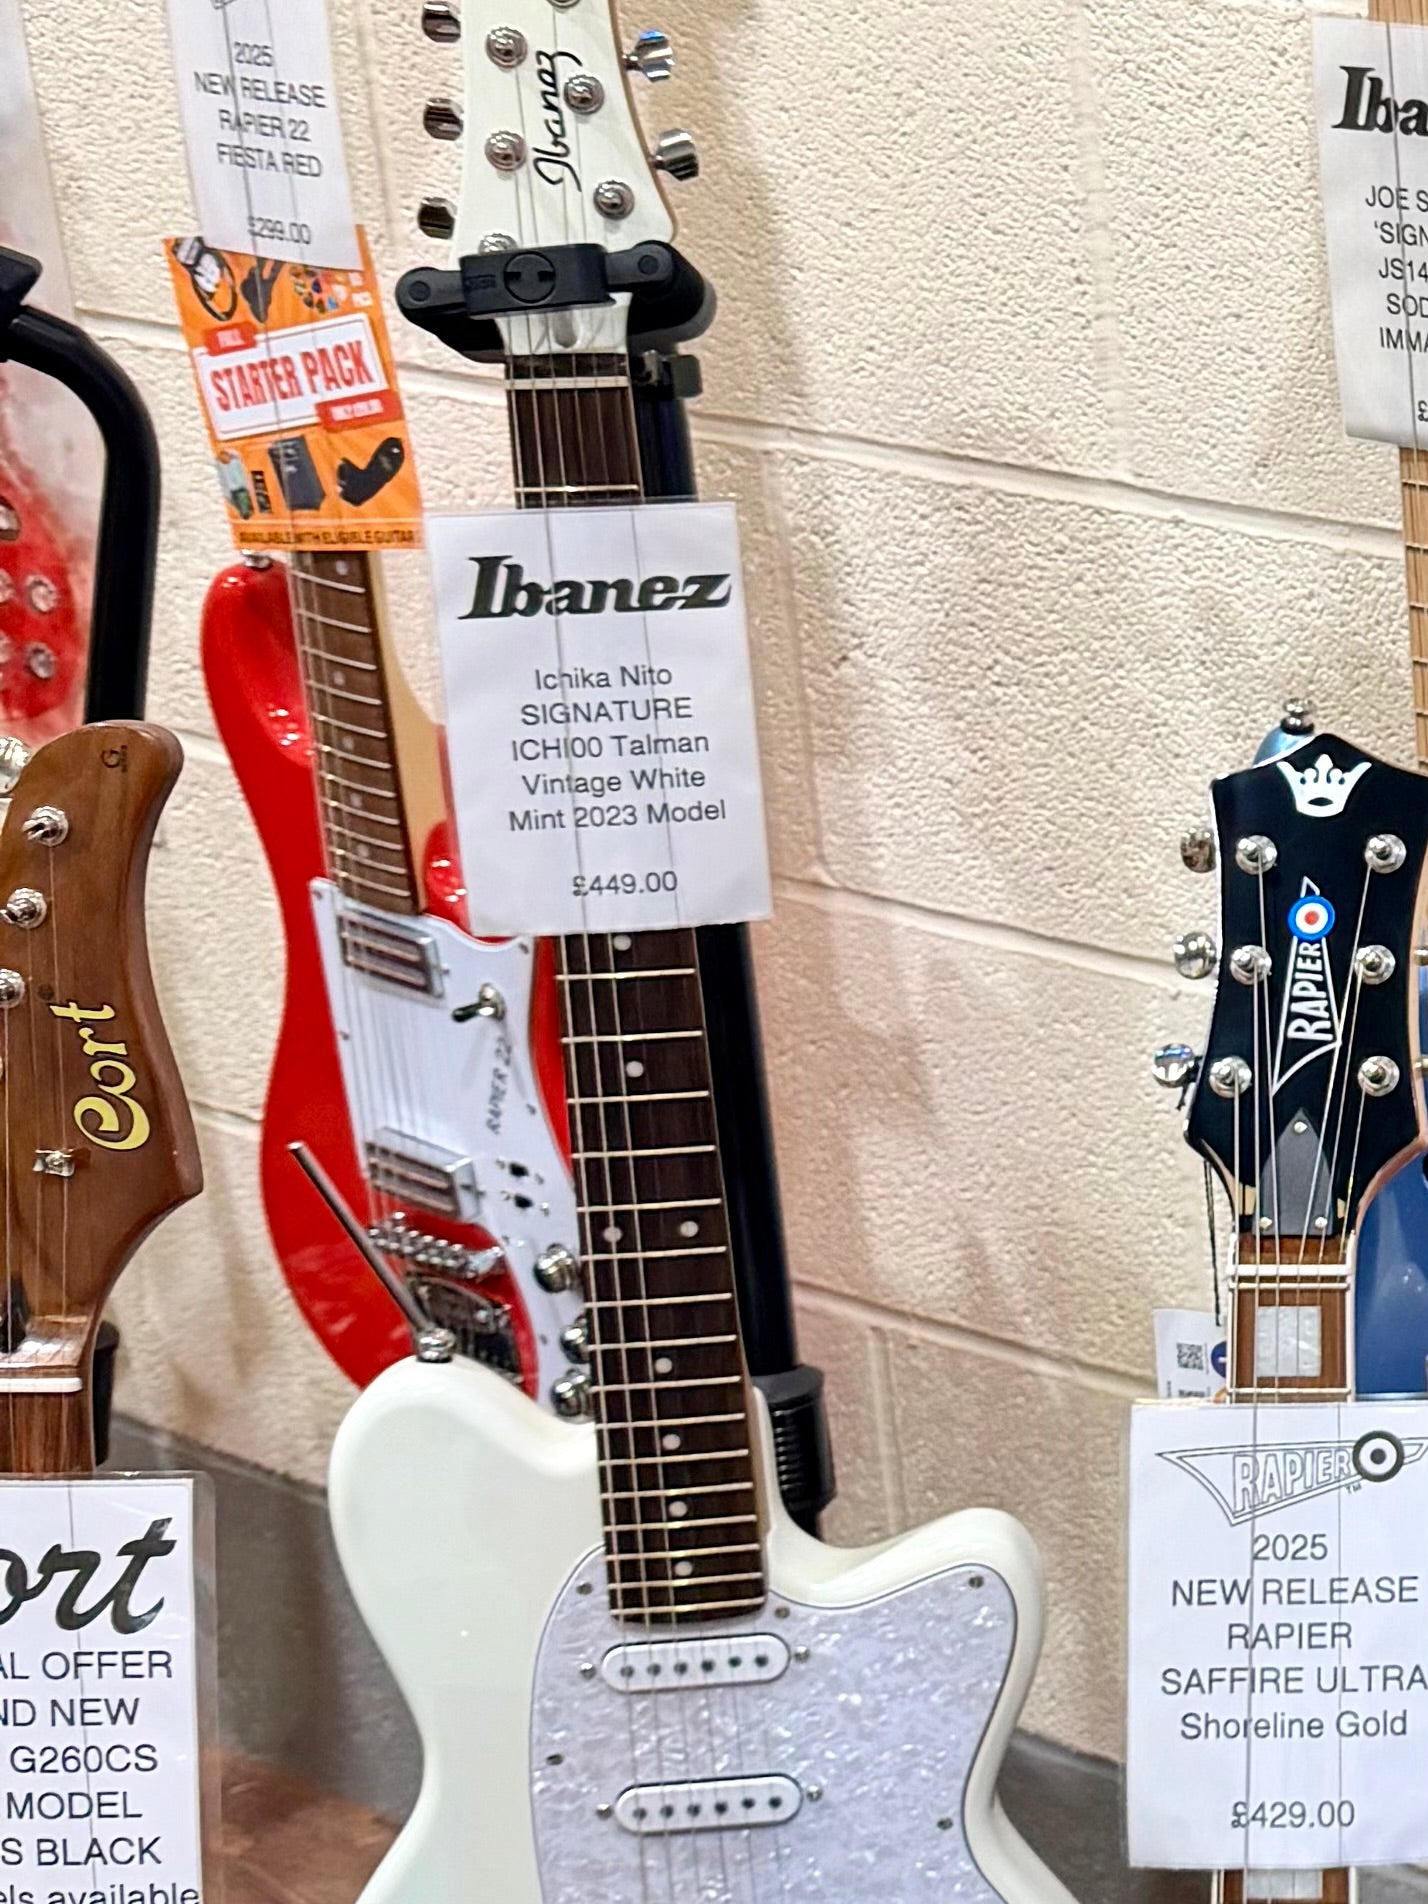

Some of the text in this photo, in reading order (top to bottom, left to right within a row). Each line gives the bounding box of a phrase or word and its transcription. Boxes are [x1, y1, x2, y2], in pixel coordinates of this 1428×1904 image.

[233, 41, 274, 68] 2025
[194, 71, 328, 109] NEW RELEASE
[218, 109, 312, 143] RAPIER 22
[532, 48, 583, 193] Ibanez
[217, 143, 322, 179] FIESTA RED
[1365, 184, 1410, 211] JOE
[210, 355, 304, 412] STARTER
[299, 339, 375, 394] PACK
[457, 554, 733, 621] Ibanez
[534, 663, 673, 691] Ichika Nito
[520, 695, 694, 727] SIGNATURE
[611, 732, 711, 758] Talman
[521, 766, 707, 799] Vintage White
[508, 798, 728, 832] Mint 2023 Model
[571, 869, 679, 897] £449.00
[1286, 938, 1334, 1042] RAPIER
[48, 997, 152, 1152] Cort
[1232, 1449, 1352, 1515] RAPIER
[1251, 1533, 1329, 1562] 2025
[1170, 1575, 1420, 1609] NEW RELEASE
[1226, 1621, 1354, 1651] RAPIER
[41, 1649, 174, 1681] OFFER
[1160, 1666, 1304, 1697] SAFFIRE
[50, 1697, 141, 1728] NEW
[1179, 1708, 1408, 1742] Shoreline Gold
[9, 1743, 159, 1775] G260CS
[5, 1791, 144, 1821] MODEL
[1230, 1799, 1356, 1830] £429.00
[36, 1835, 163, 1867] BLACK
